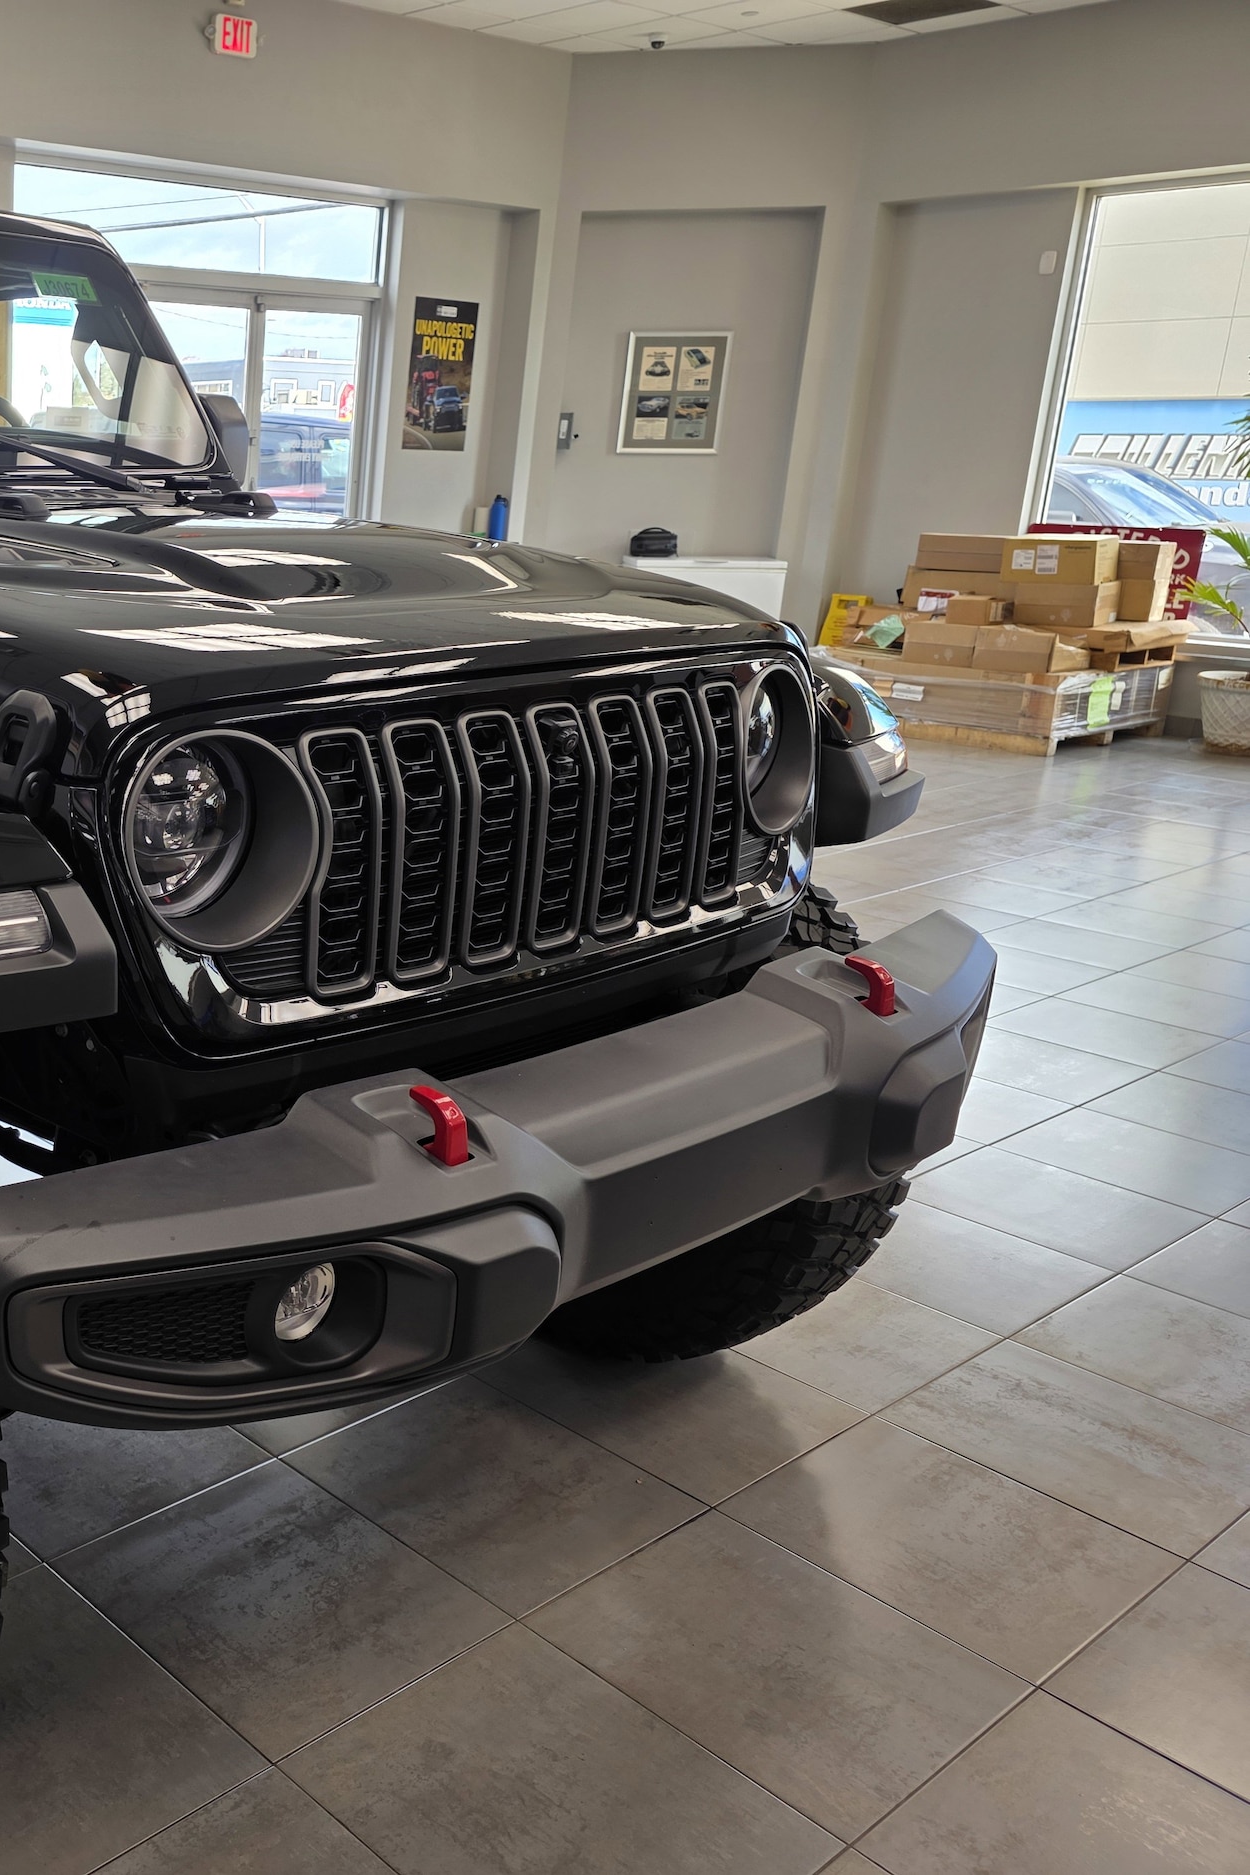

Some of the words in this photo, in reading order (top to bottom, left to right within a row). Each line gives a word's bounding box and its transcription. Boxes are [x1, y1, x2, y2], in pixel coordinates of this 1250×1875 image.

[222, 16, 253, 54] EXIT
[43, 279, 91, 299] J30674
[415, 318, 475, 340] UNAPOLOGETIC
[422, 335, 465, 361] POWER
